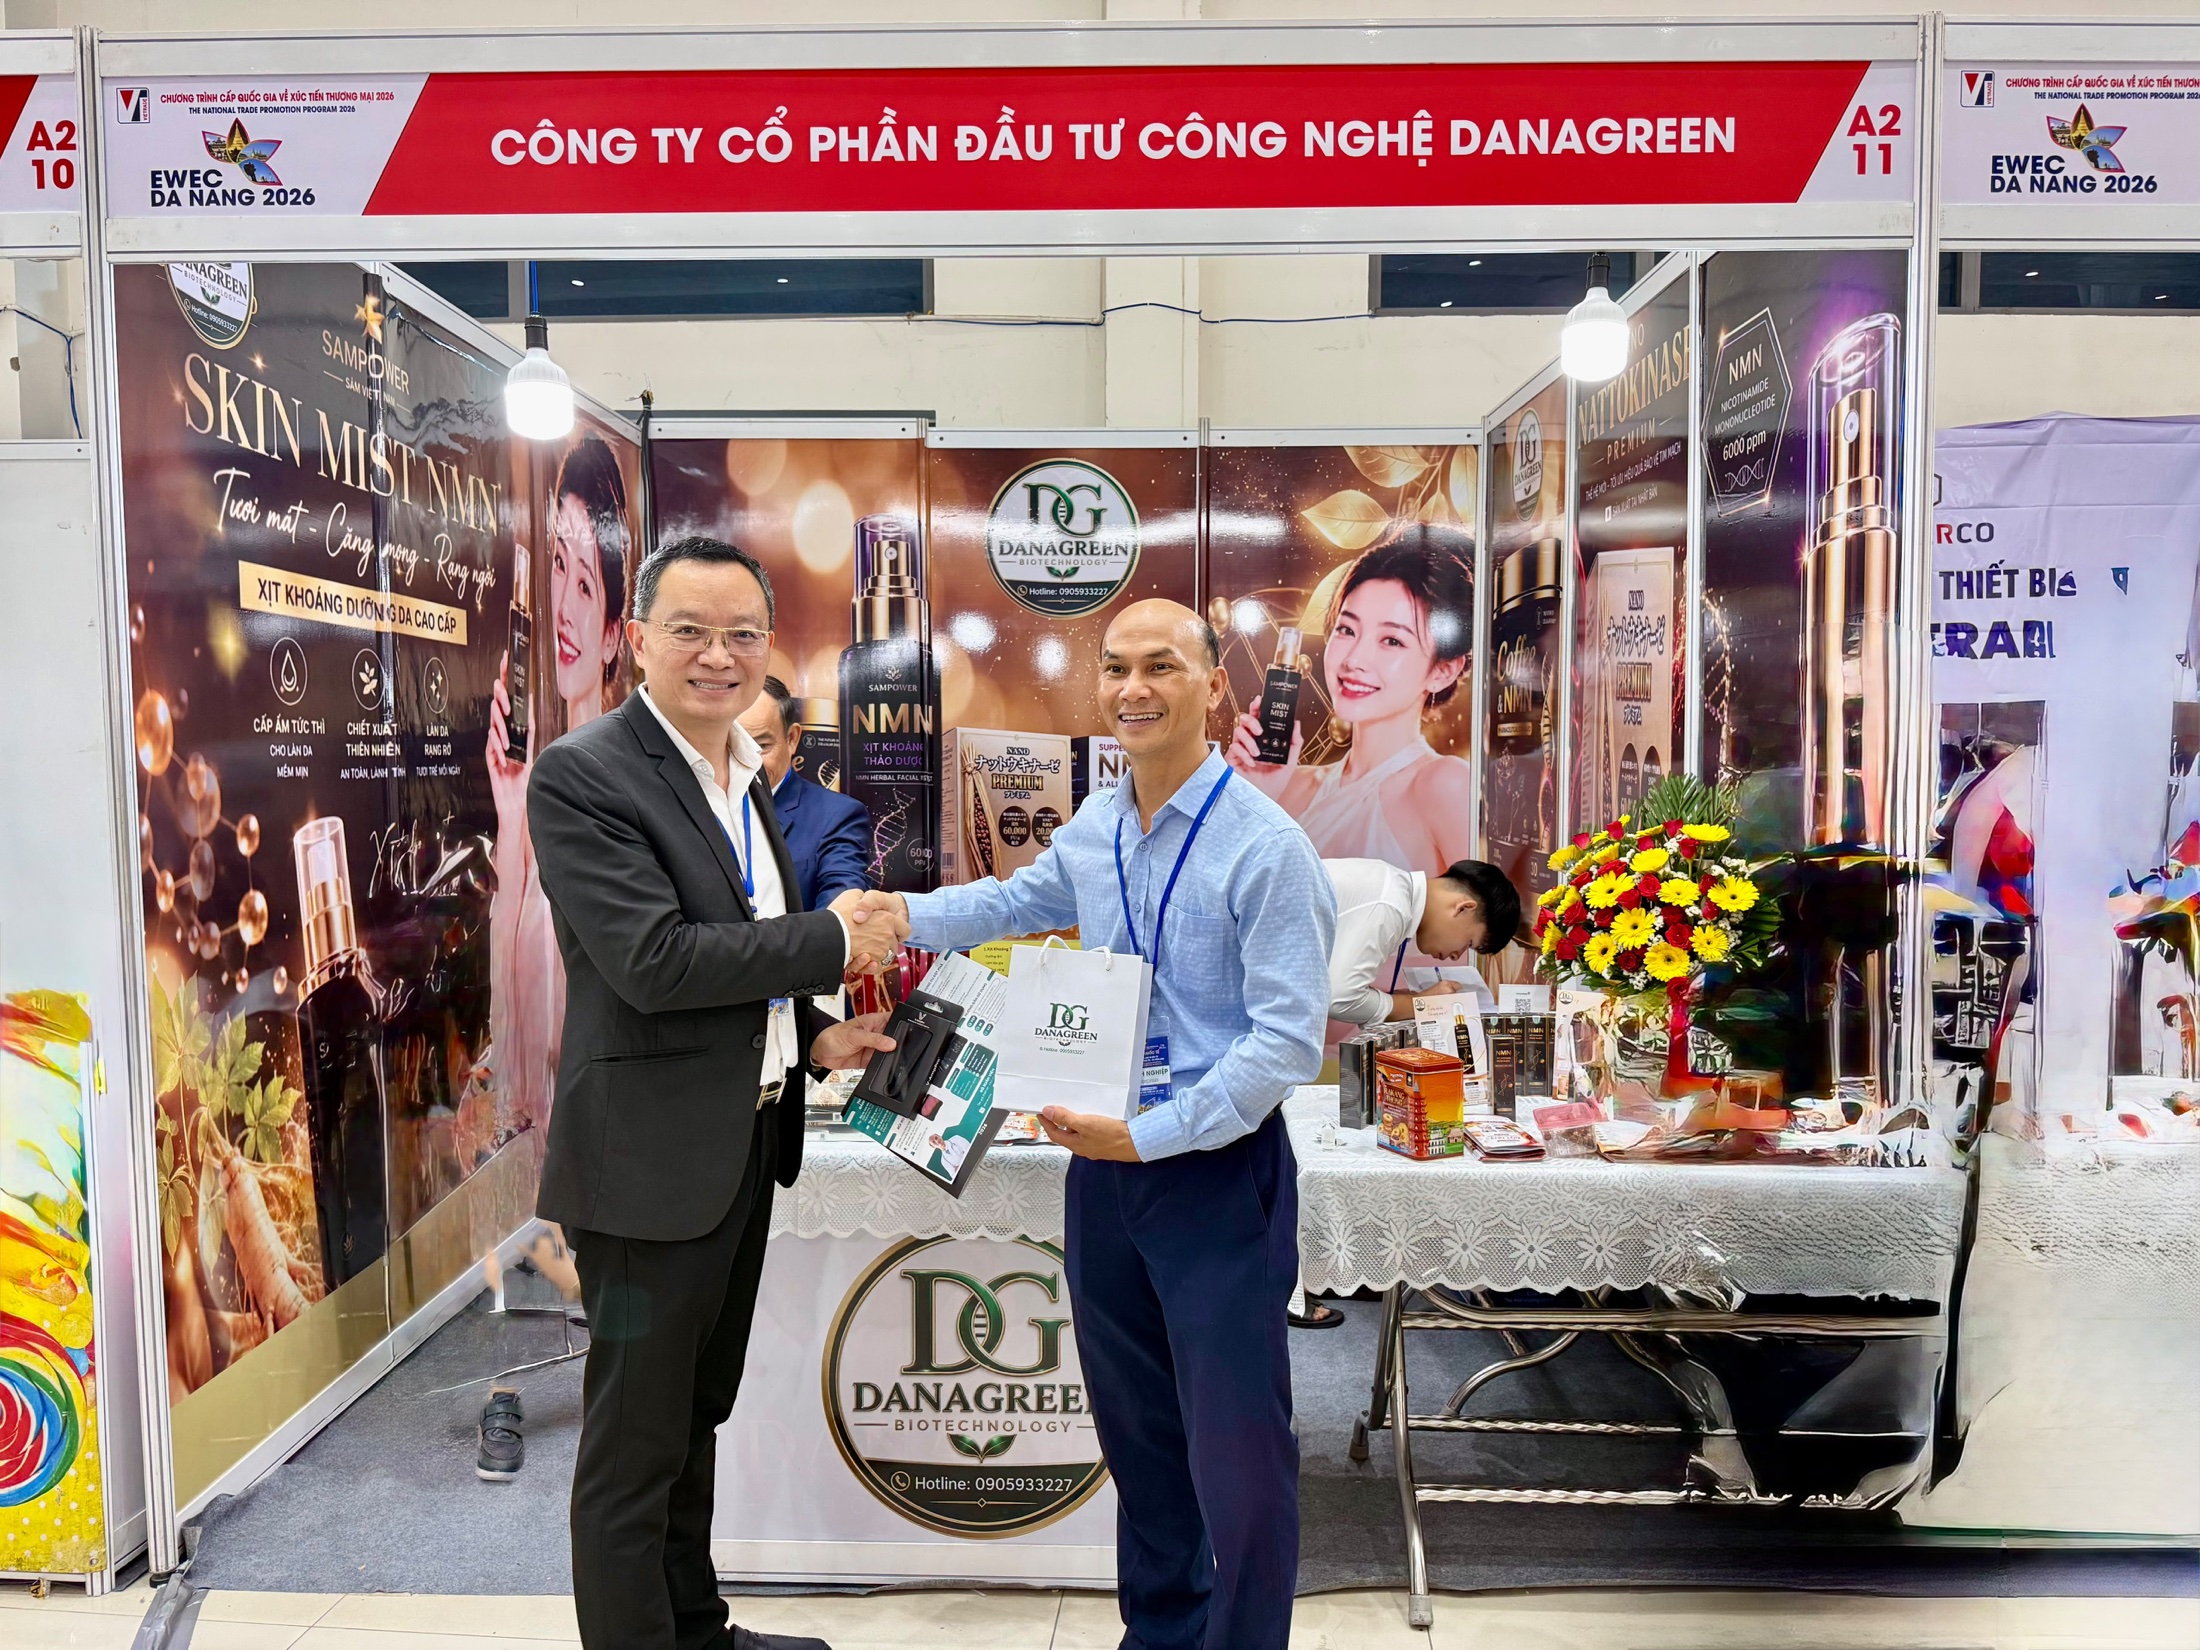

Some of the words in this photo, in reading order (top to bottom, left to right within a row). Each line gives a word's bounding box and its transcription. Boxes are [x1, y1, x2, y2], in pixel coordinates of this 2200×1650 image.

[2042, 76, 2064, 87] TRÌNH
[2066, 74, 2083, 87] CẤP
[2084, 75, 2108, 87] QUỐC
[2110, 78, 2124, 88] GIA
[2137, 76, 2155, 88] XÚC
[2156, 75, 2172, 88] TIẾN
[2174, 77, 2200, 88] THƯƠN
[196, 91, 218, 103] TRÌNH
[220, 90, 236, 102] CẤP
[238, 90, 261, 102] QUỐC
[263, 93, 277, 102] GIA
[290, 90, 307, 101] XÚC
[308, 89, 324, 101] TIẾN
[326, 91, 358, 101] THƯƠNG
[359, 92, 374, 103] MẠI
[376, 92, 394, 101] 2026
[202, 106, 236, 114] NATIONAL
[339, 105, 355, 113] 2026
[1847, 104, 1901, 137] A2
[26, 121, 76, 151] A2
[491, 118, 637, 166] CÔNG
[651, 127, 703, 164] TY
[718, 106, 793, 164] CỔ
[810, 105, 937, 162] PHẦN
[954, 106, 1053, 162] ĐẦU
[1068, 118, 1127, 161] TƯ
[1138, 111, 1287, 159] CÔNG
[1303, 109, 1434, 167] NGHỆ
[1450, 116, 1735, 156] DANAGREEN
[1852, 143, 1893, 175] 11
[1991, 155, 2065, 175] EWEC
[32, 158, 74, 190] 10
[150, 169, 223, 188] EWEC
[1990, 175, 2022, 193] DA
[2030, 175, 2097, 193] NANG
[2104, 175, 2158, 193] 2026
[151, 190, 182, 207] DA
[190, 188, 255, 207] NANG
[262, 188, 316, 206] 2026
[184, 270, 236, 303] BIOTECHNOLOGY
[322, 329, 410, 396] SAMPOWER
[1728, 344, 1763, 385] NMN
[1720, 377, 1769, 414] NICOTINAMIDE
[1714, 393, 1776, 436] MONONUCLEOTIDE
[184, 352, 303, 468] SKIN
[315, 408, 416, 505] MIST
[424, 454, 500, 537] NMN
[1607, 417, 1656, 465] PREMIUM
[1723, 437, 1745, 461] 6000
[1746, 430, 1767, 456] ppm
[213, 467, 261, 534] Tươi
[265, 499, 310, 544] mát
[325, 502, 376, 578] Căng
[1936, 522, 1995, 544] RCO
[998, 540, 1129, 556] DANAGREEN
[1019, 558, 1108, 566] BIOTECHNOLOGY
[1938, 559, 2019, 600] THIẾT
[1029, 587, 1058, 596] Hotline:
[1059, 587, 1108, 596] 0905933227
[257, 578, 281, 608] XỊT
[285, 583, 343, 615] KHOÁNG
[398, 605, 414, 627] DA
[414, 608, 435, 631] CAO
[437, 610, 457, 634] CẤP
[1497, 633, 1536, 682] Coffee
[868, 684, 918, 692] SAMPOWER
[1616, 662, 1652, 702] PREMIUM
[1271, 701, 1290, 711] SKIN
[1504, 681, 1532, 714] NMN
[253, 713, 273, 734] CẤP
[291, 716, 310, 734] TỨC
[853, 703, 933, 735] NMN
[1270, 709, 1289, 718] MIST
[270, 745, 286, 757] CHO
[287, 743, 302, 757] LÀN
[302, 745, 313, 757] DA
[345, 741, 370, 757] THIÊN
[863, 742, 880, 754] XỊT
[1007, 747, 1030, 756] NANO
[864, 754, 893, 766] THẢO
[991, 773, 1044, 791] PREMIUM
[1047, 1002, 1089, 1030] DG
[1034, 1027, 1098, 1041] DANAGREEN
[1146, 1067, 1168, 1077] NGHIỆP
[900, 1268, 1071, 1377] DG
[852, 1382, 1093, 1414] DANAGREE
[894, 1418, 1072, 1432] BIOTECHNOLOGY
[914, 1475, 971, 1491] Hotline:
[975, 1476, 1073, 1492] 0905933227
